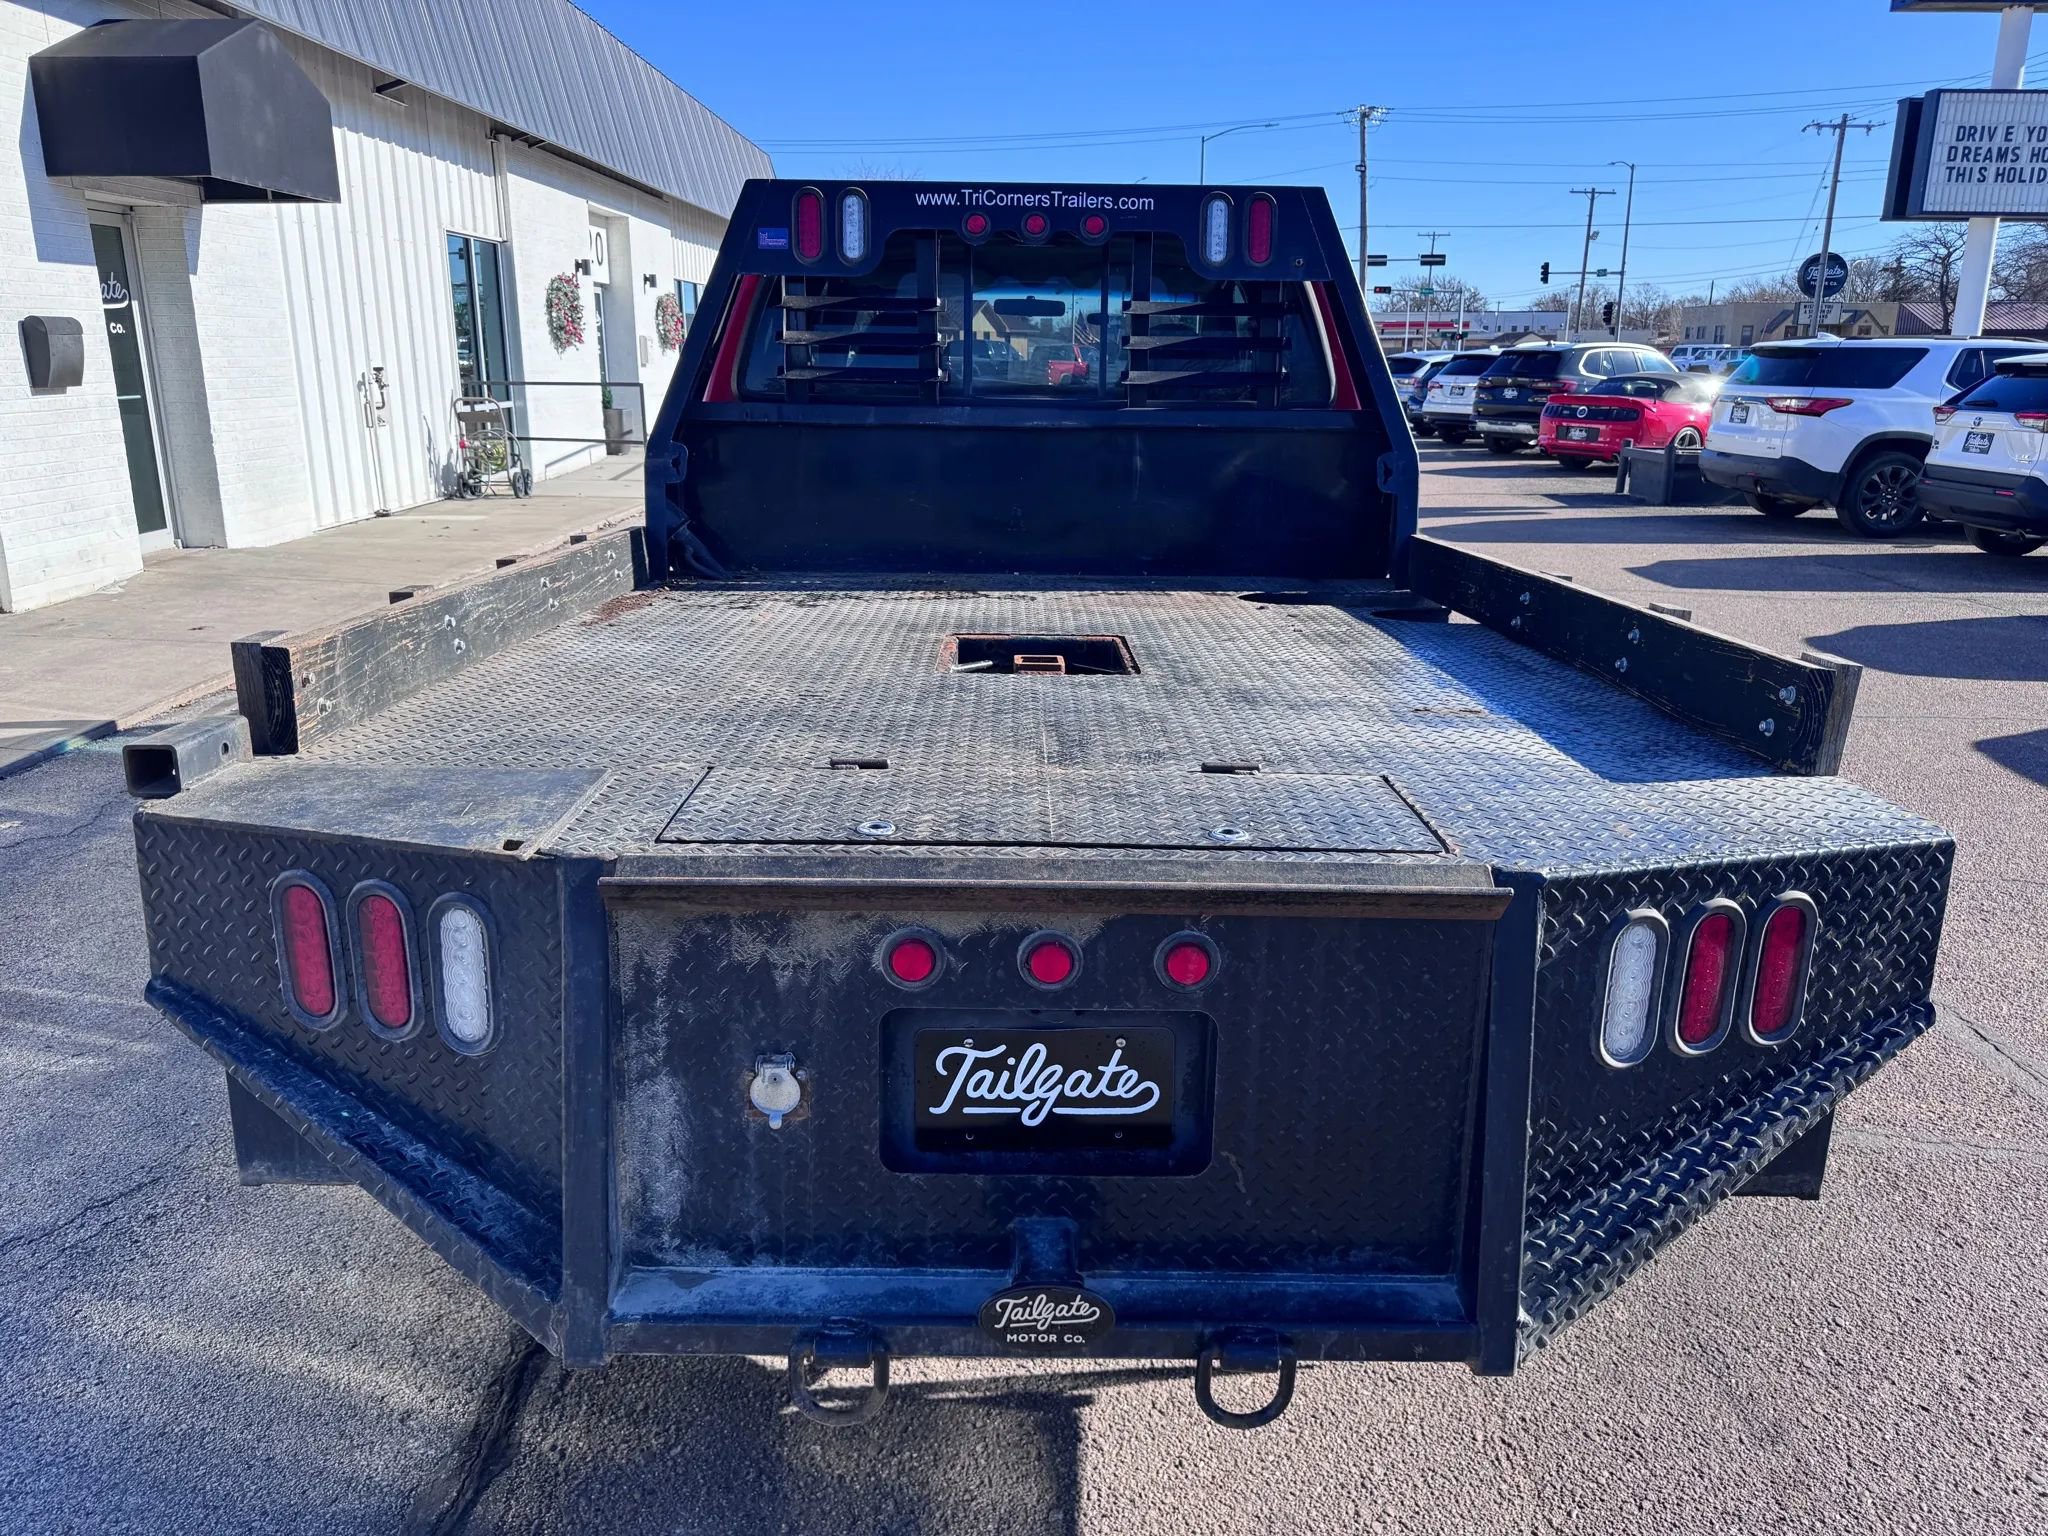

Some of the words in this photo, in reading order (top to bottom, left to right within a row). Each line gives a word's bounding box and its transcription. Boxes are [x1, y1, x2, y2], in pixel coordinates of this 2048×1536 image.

[1956, 125, 2015, 142] DRIVE
[1946, 146, 2021, 163] DREAMS
[1945, 166, 1988, 183] THIS
[1994, 166, 2048, 183] HOLID
[915, 189, 1154, 211] www.TriCornersTrailers.com
[929, 1042, 1160, 1127] Tailgate
[994, 1293, 1100, 1330] Tailgate
[1006, 1333, 1057, 1343] MOTOR
